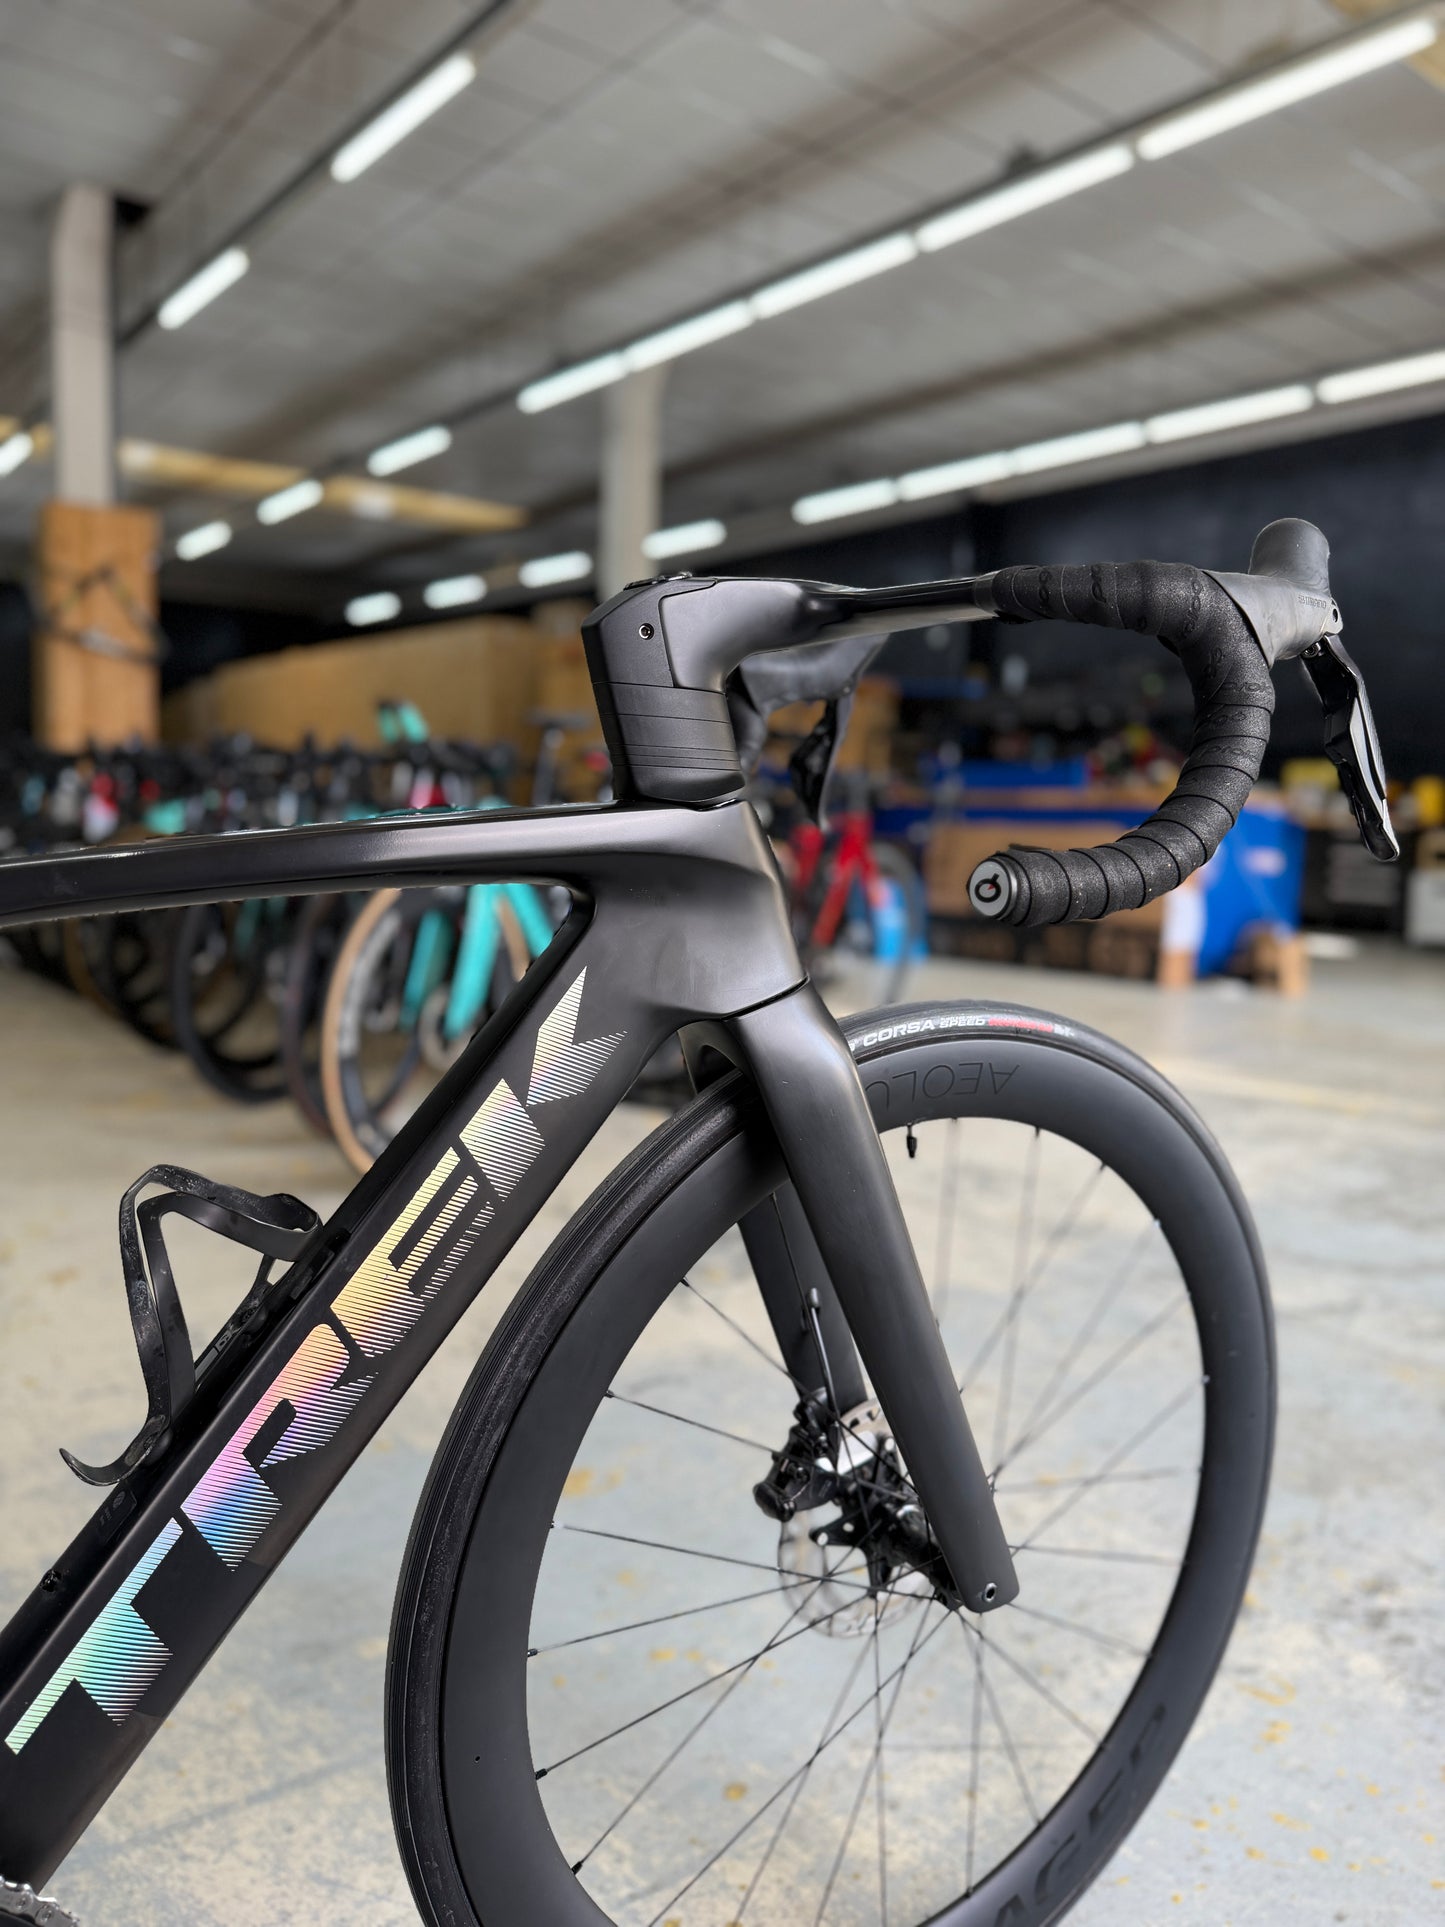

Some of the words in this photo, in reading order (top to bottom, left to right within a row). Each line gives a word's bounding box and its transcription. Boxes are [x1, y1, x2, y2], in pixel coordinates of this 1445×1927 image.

[863, 1019, 935, 1046] CORSA
[939, 1016, 985, 1029] SPEED
[5, 965, 627, 1754] TREK
